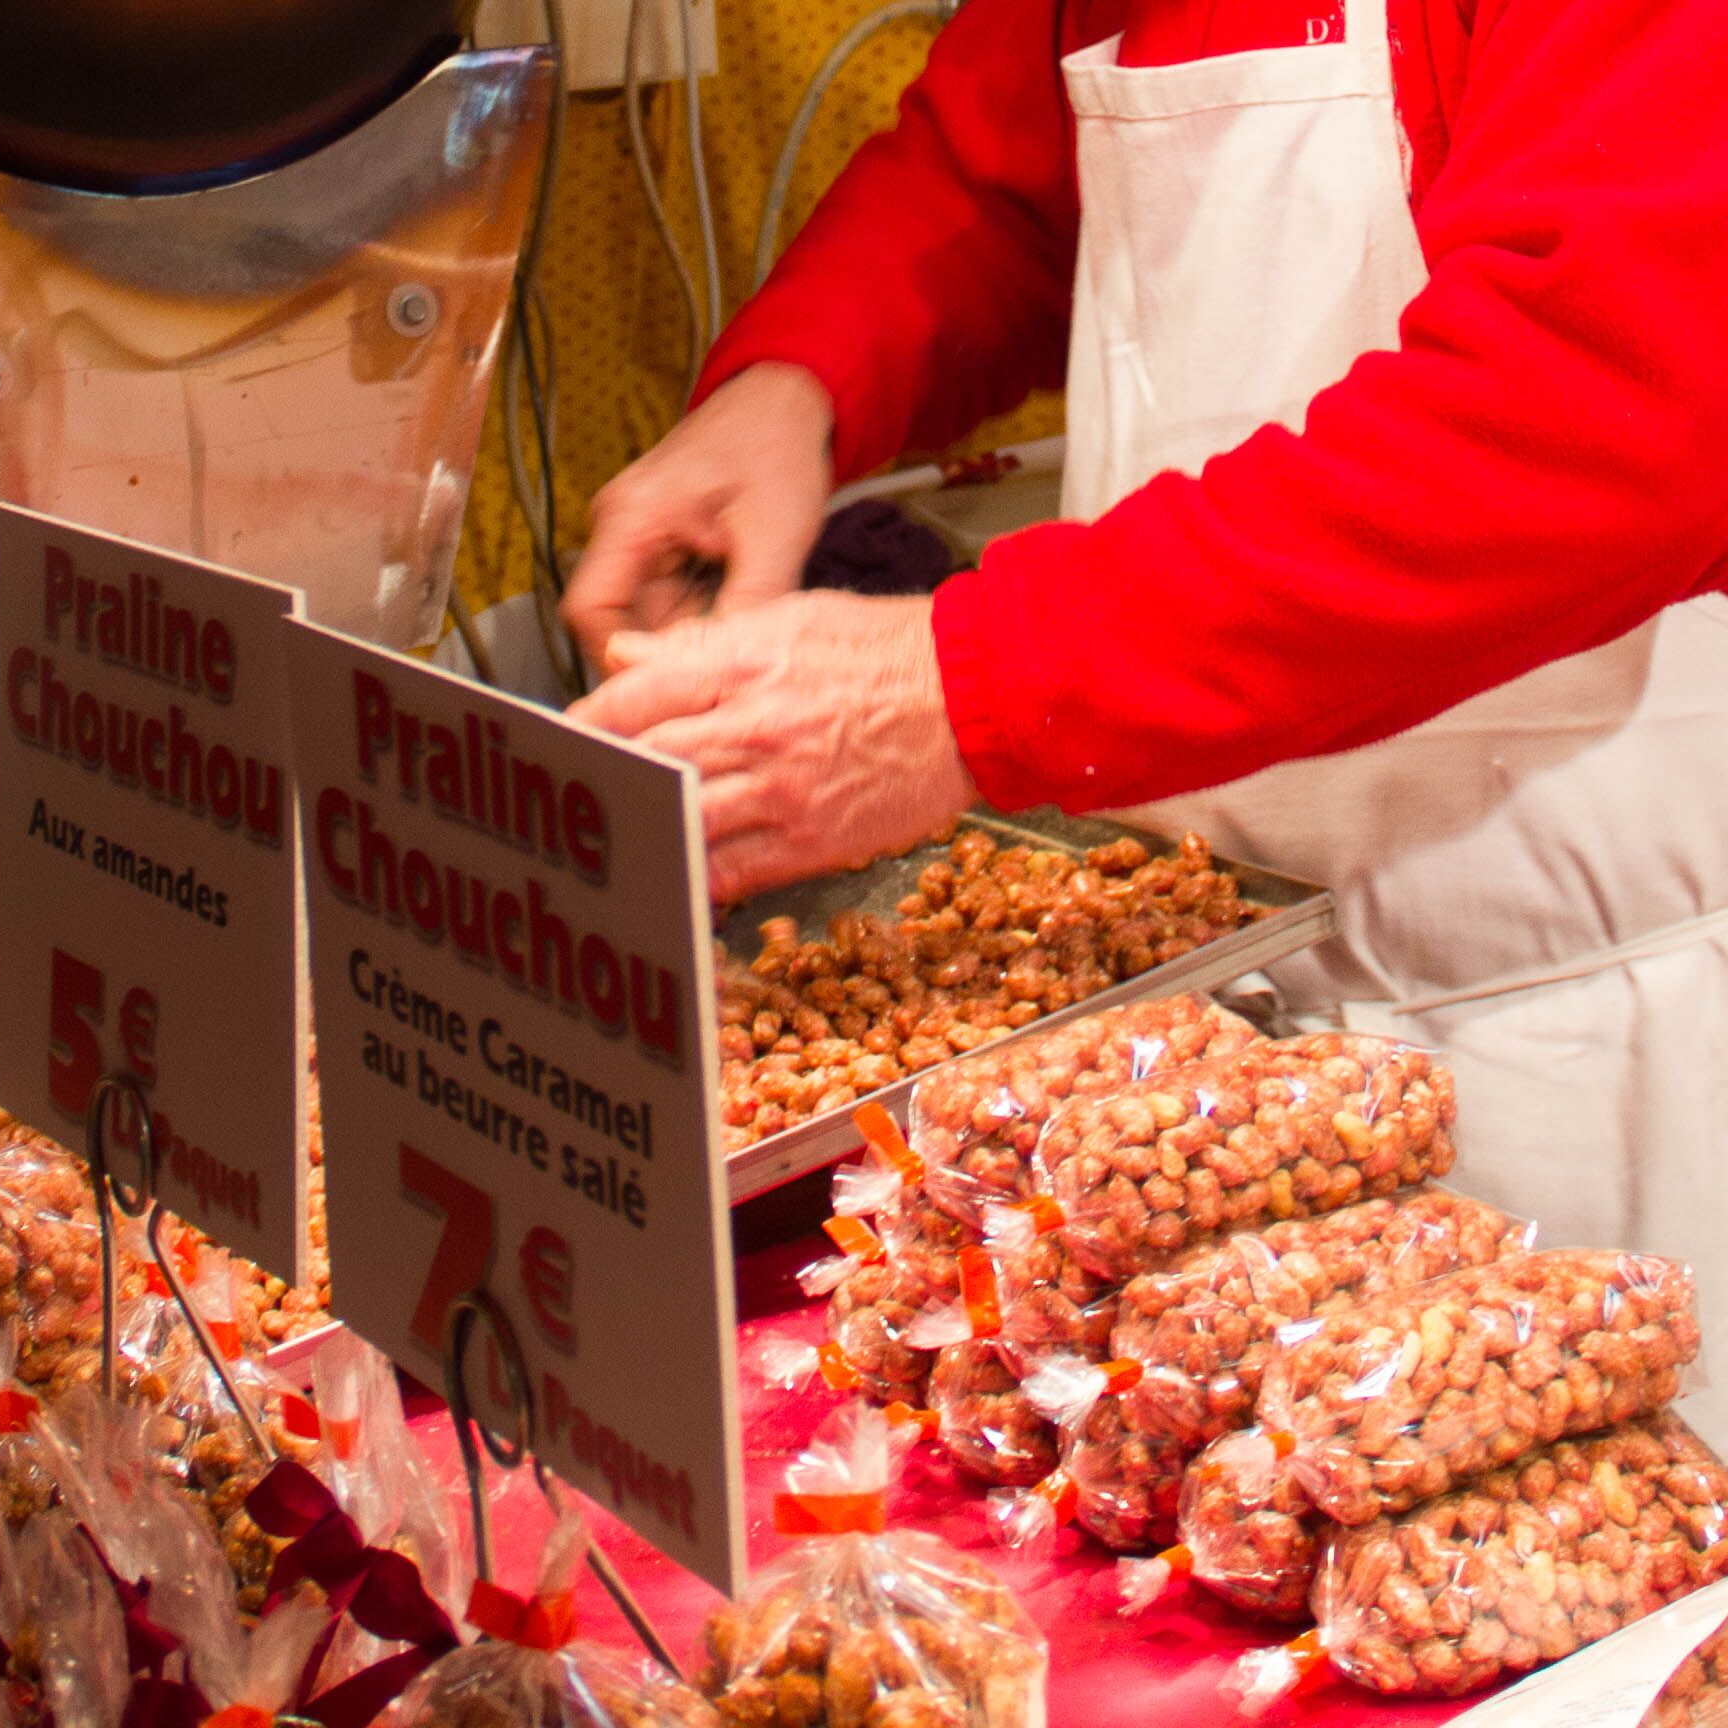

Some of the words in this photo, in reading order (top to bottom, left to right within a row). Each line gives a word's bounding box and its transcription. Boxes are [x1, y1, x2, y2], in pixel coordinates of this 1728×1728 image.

[44, 544, 235, 703] Praline
[6, 645, 284, 852] Chouchou
[351, 668, 611, 888] Praline
[29, 798, 85, 862] Aux
[93, 832, 229, 928] amandes
[316, 786, 689, 1074] Chouchou
[349, 948, 468, 1058] Crème
[478, 1018, 654, 1162] Caramel
[362, 1029, 408, 1088] au
[417, 1048, 551, 1174] beurre
[559, 1140, 648, 1229] salé
[541, 1372, 697, 1544] Paquet
